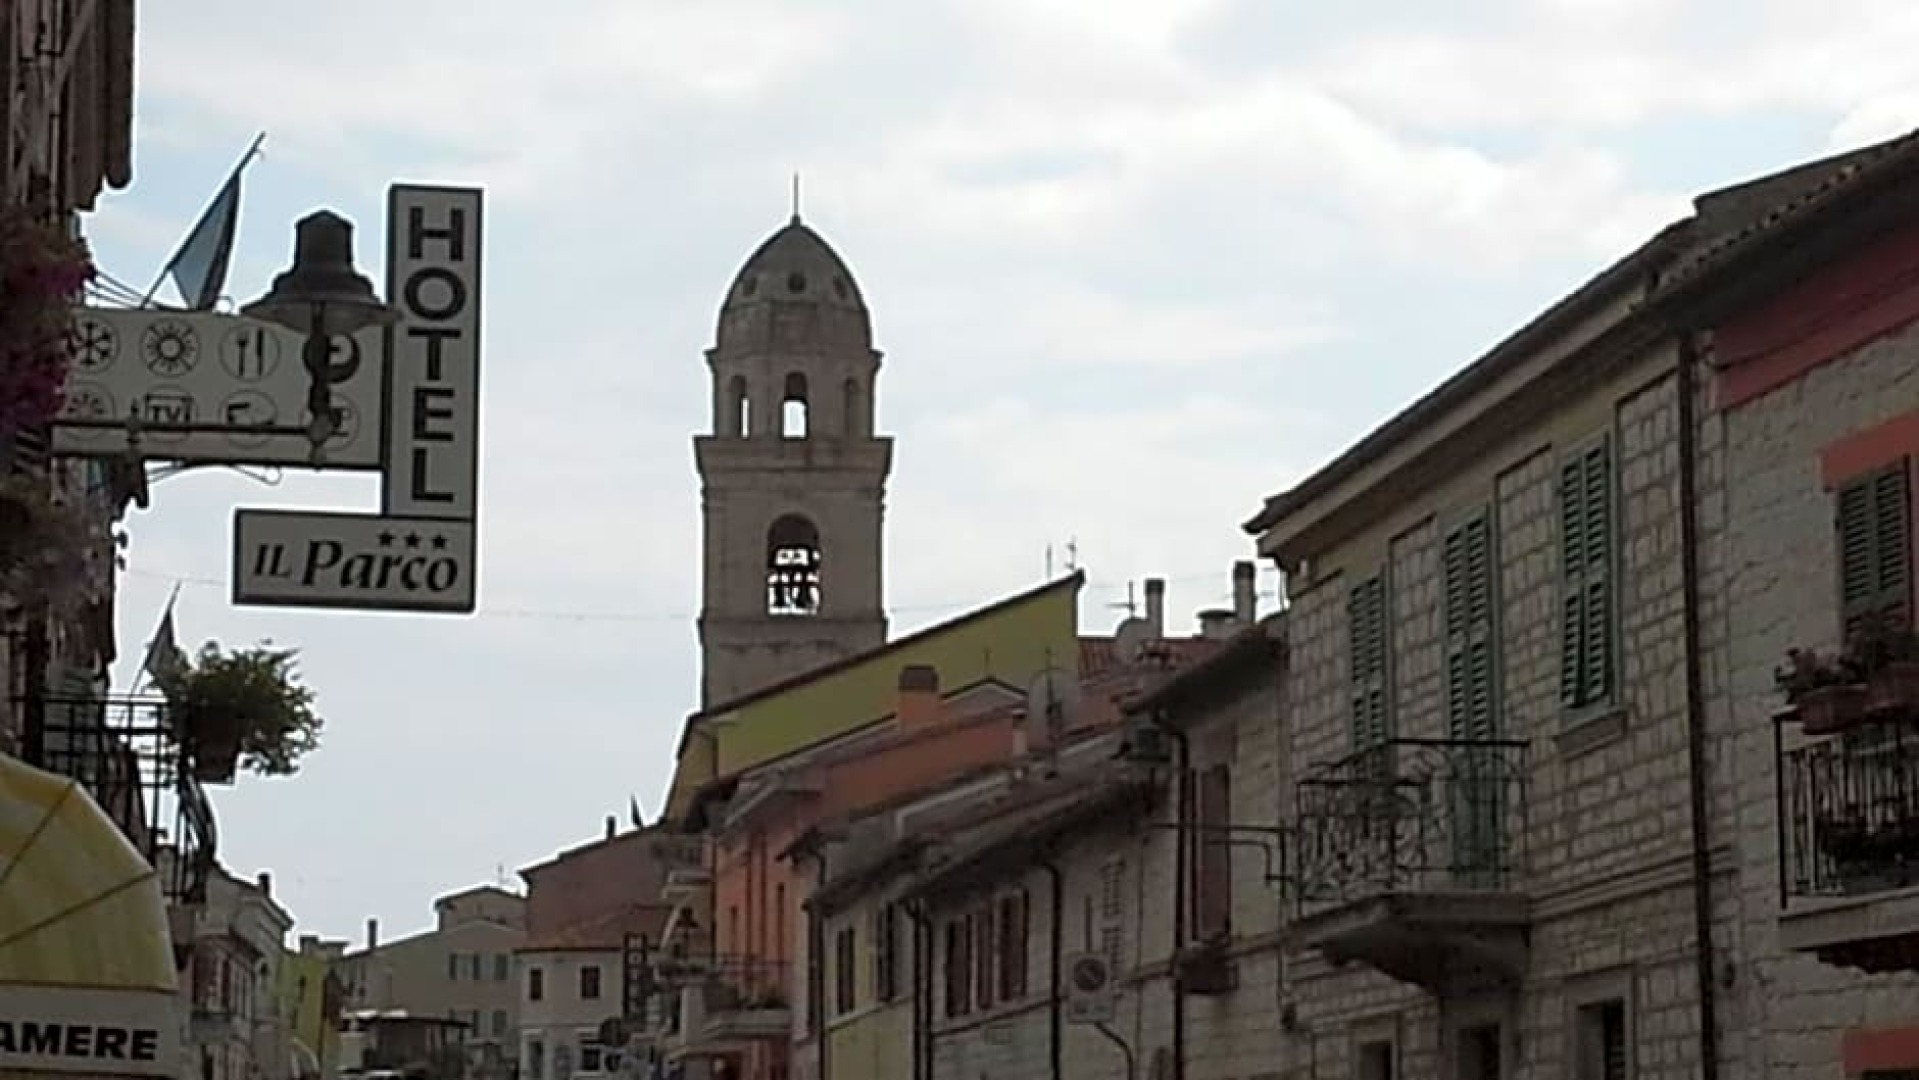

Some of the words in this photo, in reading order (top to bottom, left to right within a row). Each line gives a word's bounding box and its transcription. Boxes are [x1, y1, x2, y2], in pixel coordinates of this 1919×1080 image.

[404, 206, 467, 503] HOTEL
[253, 543, 292, 578] IL
[302, 538, 458, 592] Parco
